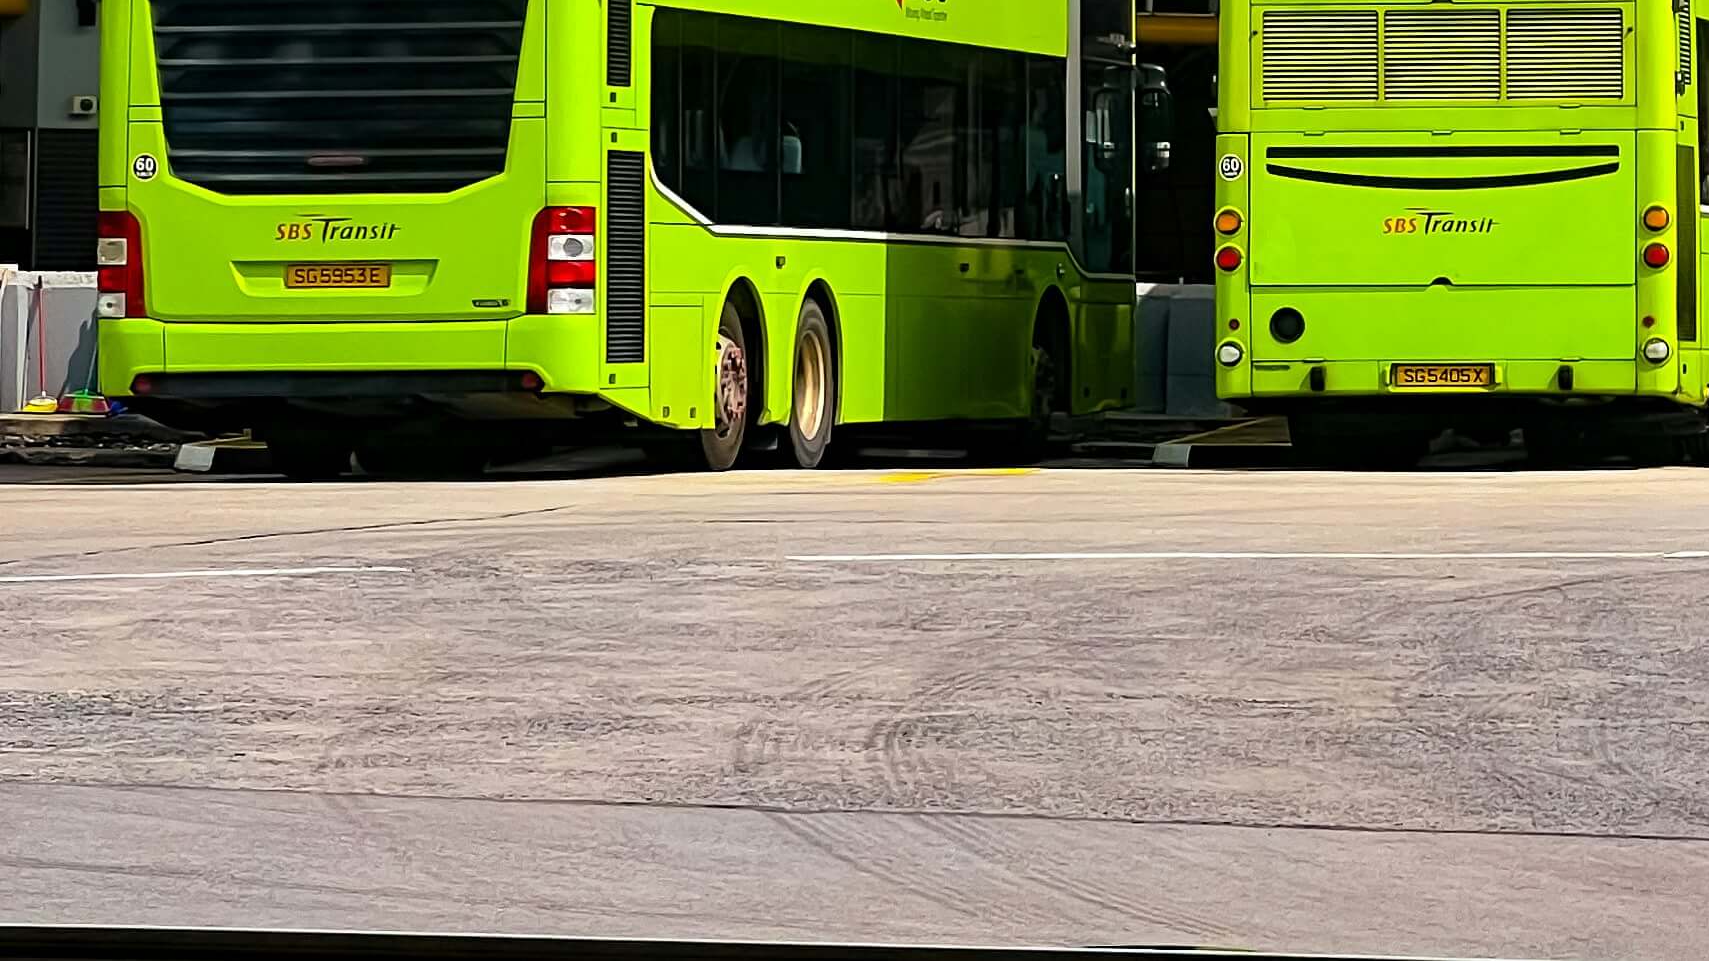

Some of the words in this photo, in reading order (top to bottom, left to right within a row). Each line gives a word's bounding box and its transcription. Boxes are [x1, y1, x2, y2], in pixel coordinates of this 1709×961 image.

[136, 158, 154, 171] 60
[1223, 158, 1240, 171] 60
[275, 223, 312, 240] SBS
[312, 218, 401, 243] Transit
[1383, 218, 1417, 234] SBS
[1416, 212, 1500, 235] Transit
[294, 267, 381, 284] SG5953E
[1404, 368, 1484, 383] SG5405X
